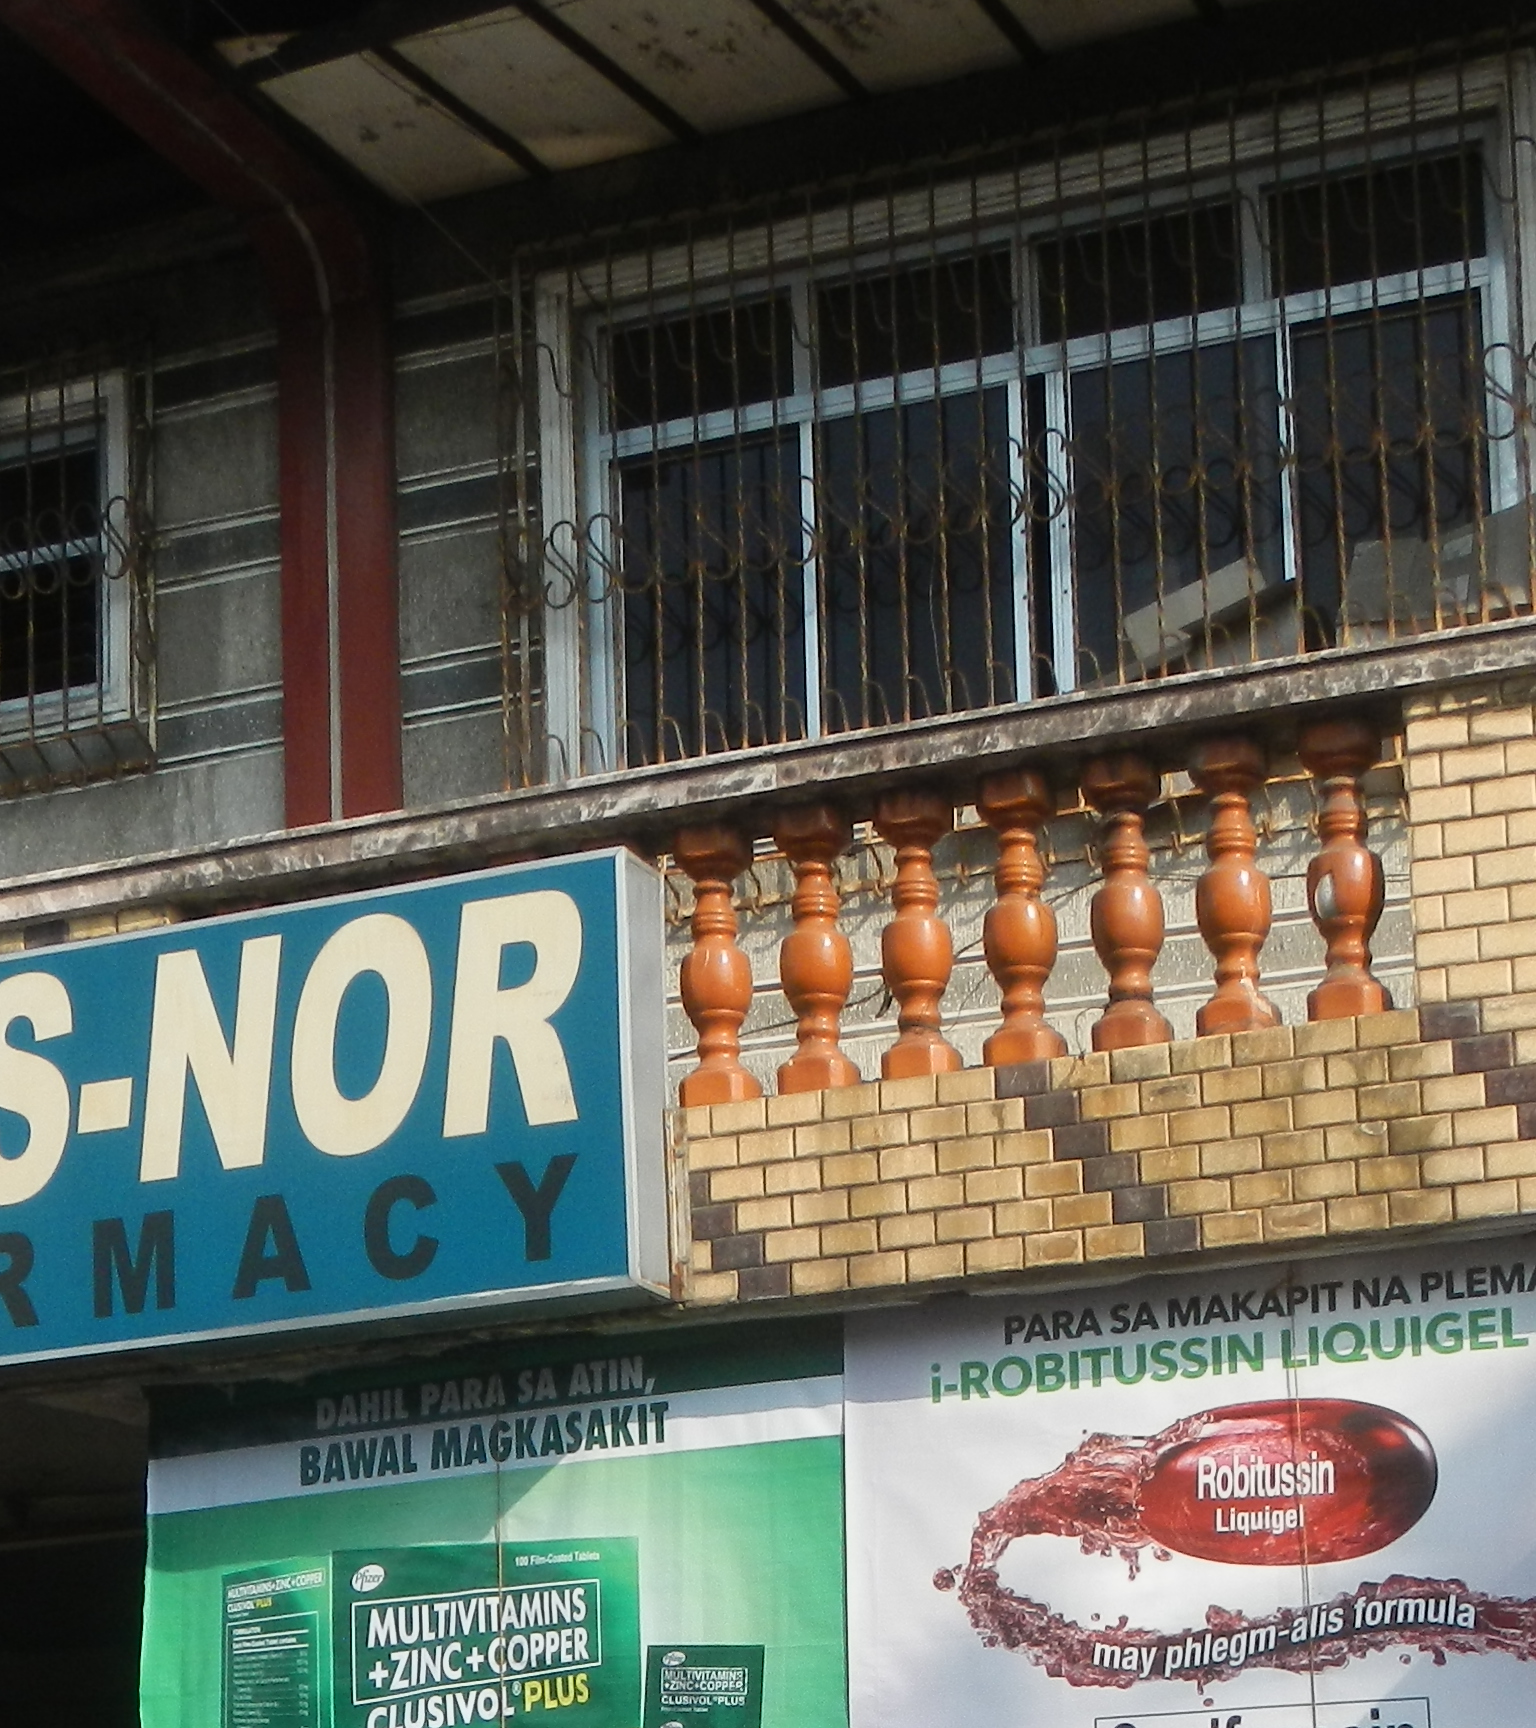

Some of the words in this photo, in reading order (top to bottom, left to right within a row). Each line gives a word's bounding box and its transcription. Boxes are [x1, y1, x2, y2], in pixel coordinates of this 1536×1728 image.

[1004, 1307, 1103, 1345] PARA
[1109, 1302, 1161, 1335] SA
[1168, 1280, 1343, 1329] MAKAPIT
[1352, 1275, 1411, 1310] NA
[929, 1328, 1265, 1404] i-ROBITUSSIN
[1279, 1306, 1530, 1370] LIQUIGEL
[315, 1386, 410, 1430] DAHIL
[419, 1373, 507, 1416] PARA
[516, 1367, 557, 1402] SA
[568, 1355, 657, 1397] ATIN,
[299, 1432, 418, 1487] BAWAL
[430, 1401, 670, 1471] MAGKASAKIT
[1196, 1451, 1336, 1501] Robitussin
[1215, 1504, 1305, 1536] Liquigel
[354, 1569, 383, 1590] Pfizer
[366, 1586, 588, 1650] MULTIVITAMINS
[1092, 1638, 1157, 1679] may
[1163, 1601, 1345, 1678] phlegm-alis
[1353, 1593, 1477, 1631] formula
[524, 1672, 590, 1713] PLUS
